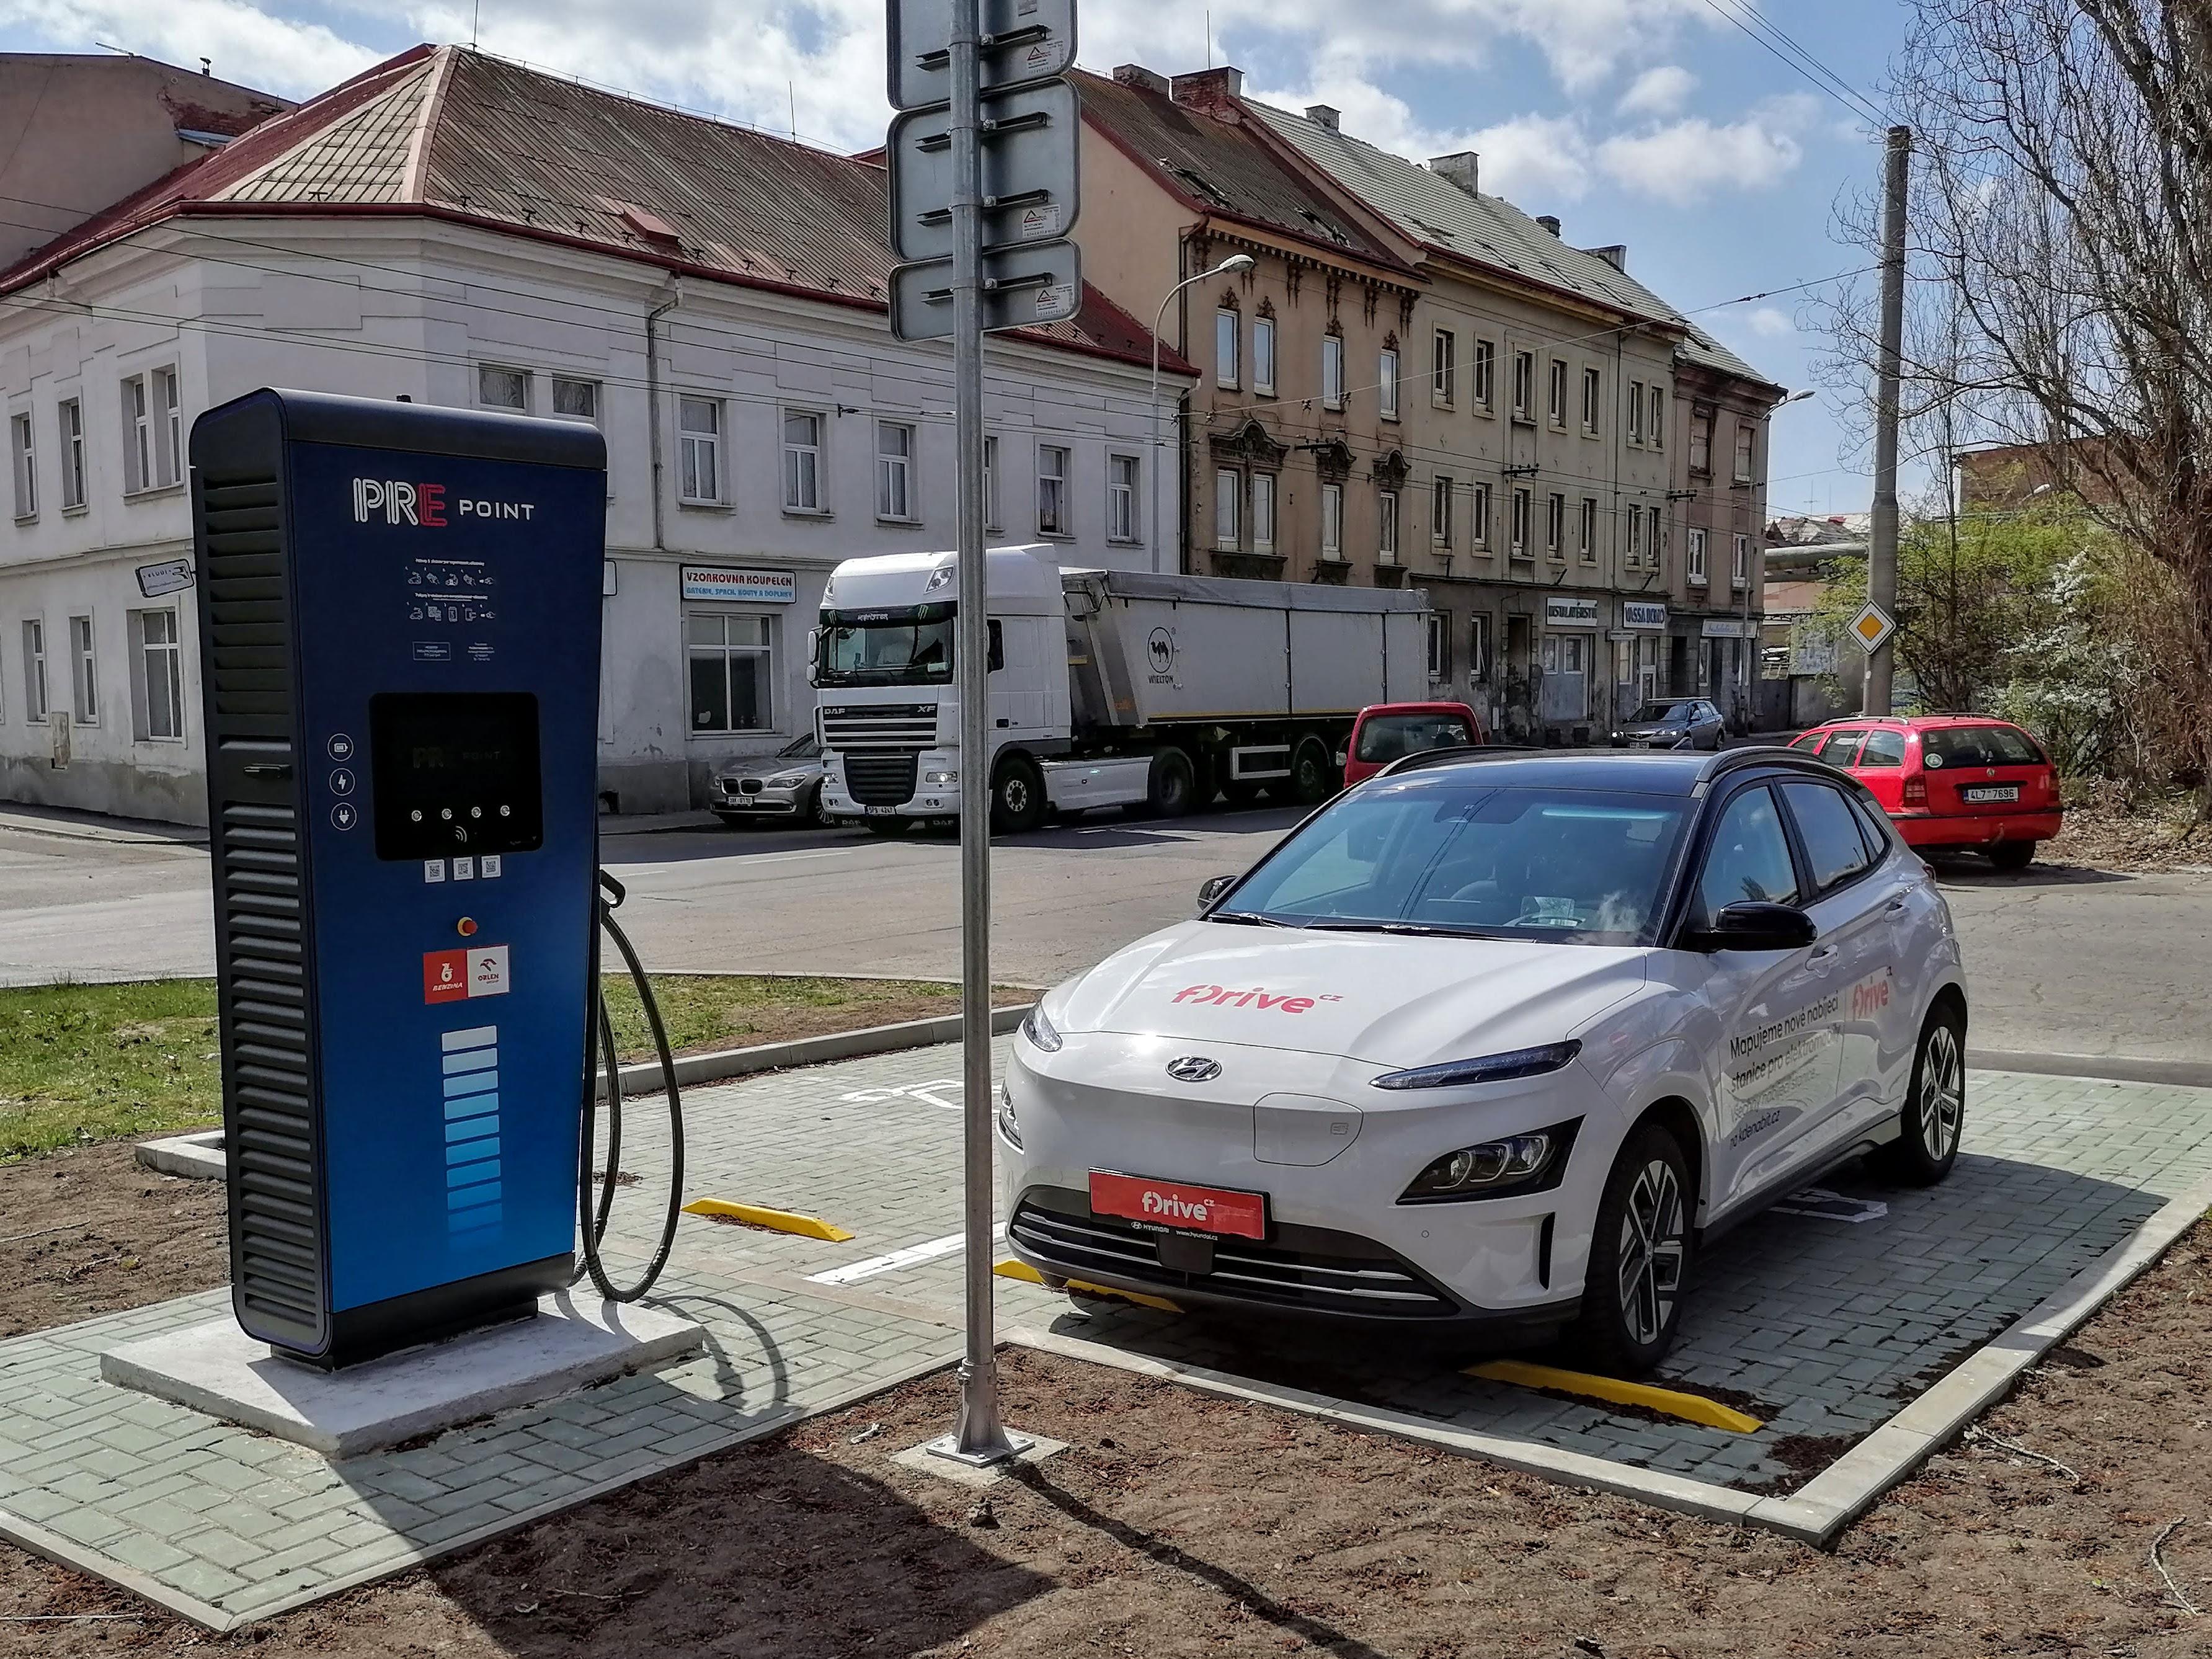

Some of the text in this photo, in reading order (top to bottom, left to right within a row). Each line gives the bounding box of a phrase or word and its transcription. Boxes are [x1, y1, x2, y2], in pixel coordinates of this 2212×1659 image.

[353, 478, 535, 527] PRE POINT
[686, 572, 792, 587] VZORKOVNA KOUPELEN
[1148, 675, 1174, 685] WIELTON
[477, 973, 499, 982] ORLEN
[433, 982, 463, 992] BENZINA
[1730, 1023, 1783, 1059] Mapujeme
[1731, 1062, 1767, 1093] stanice
[1768, 1054, 1783, 1079] pro
[1143, 1224, 1170, 1234] HYUNDAI
